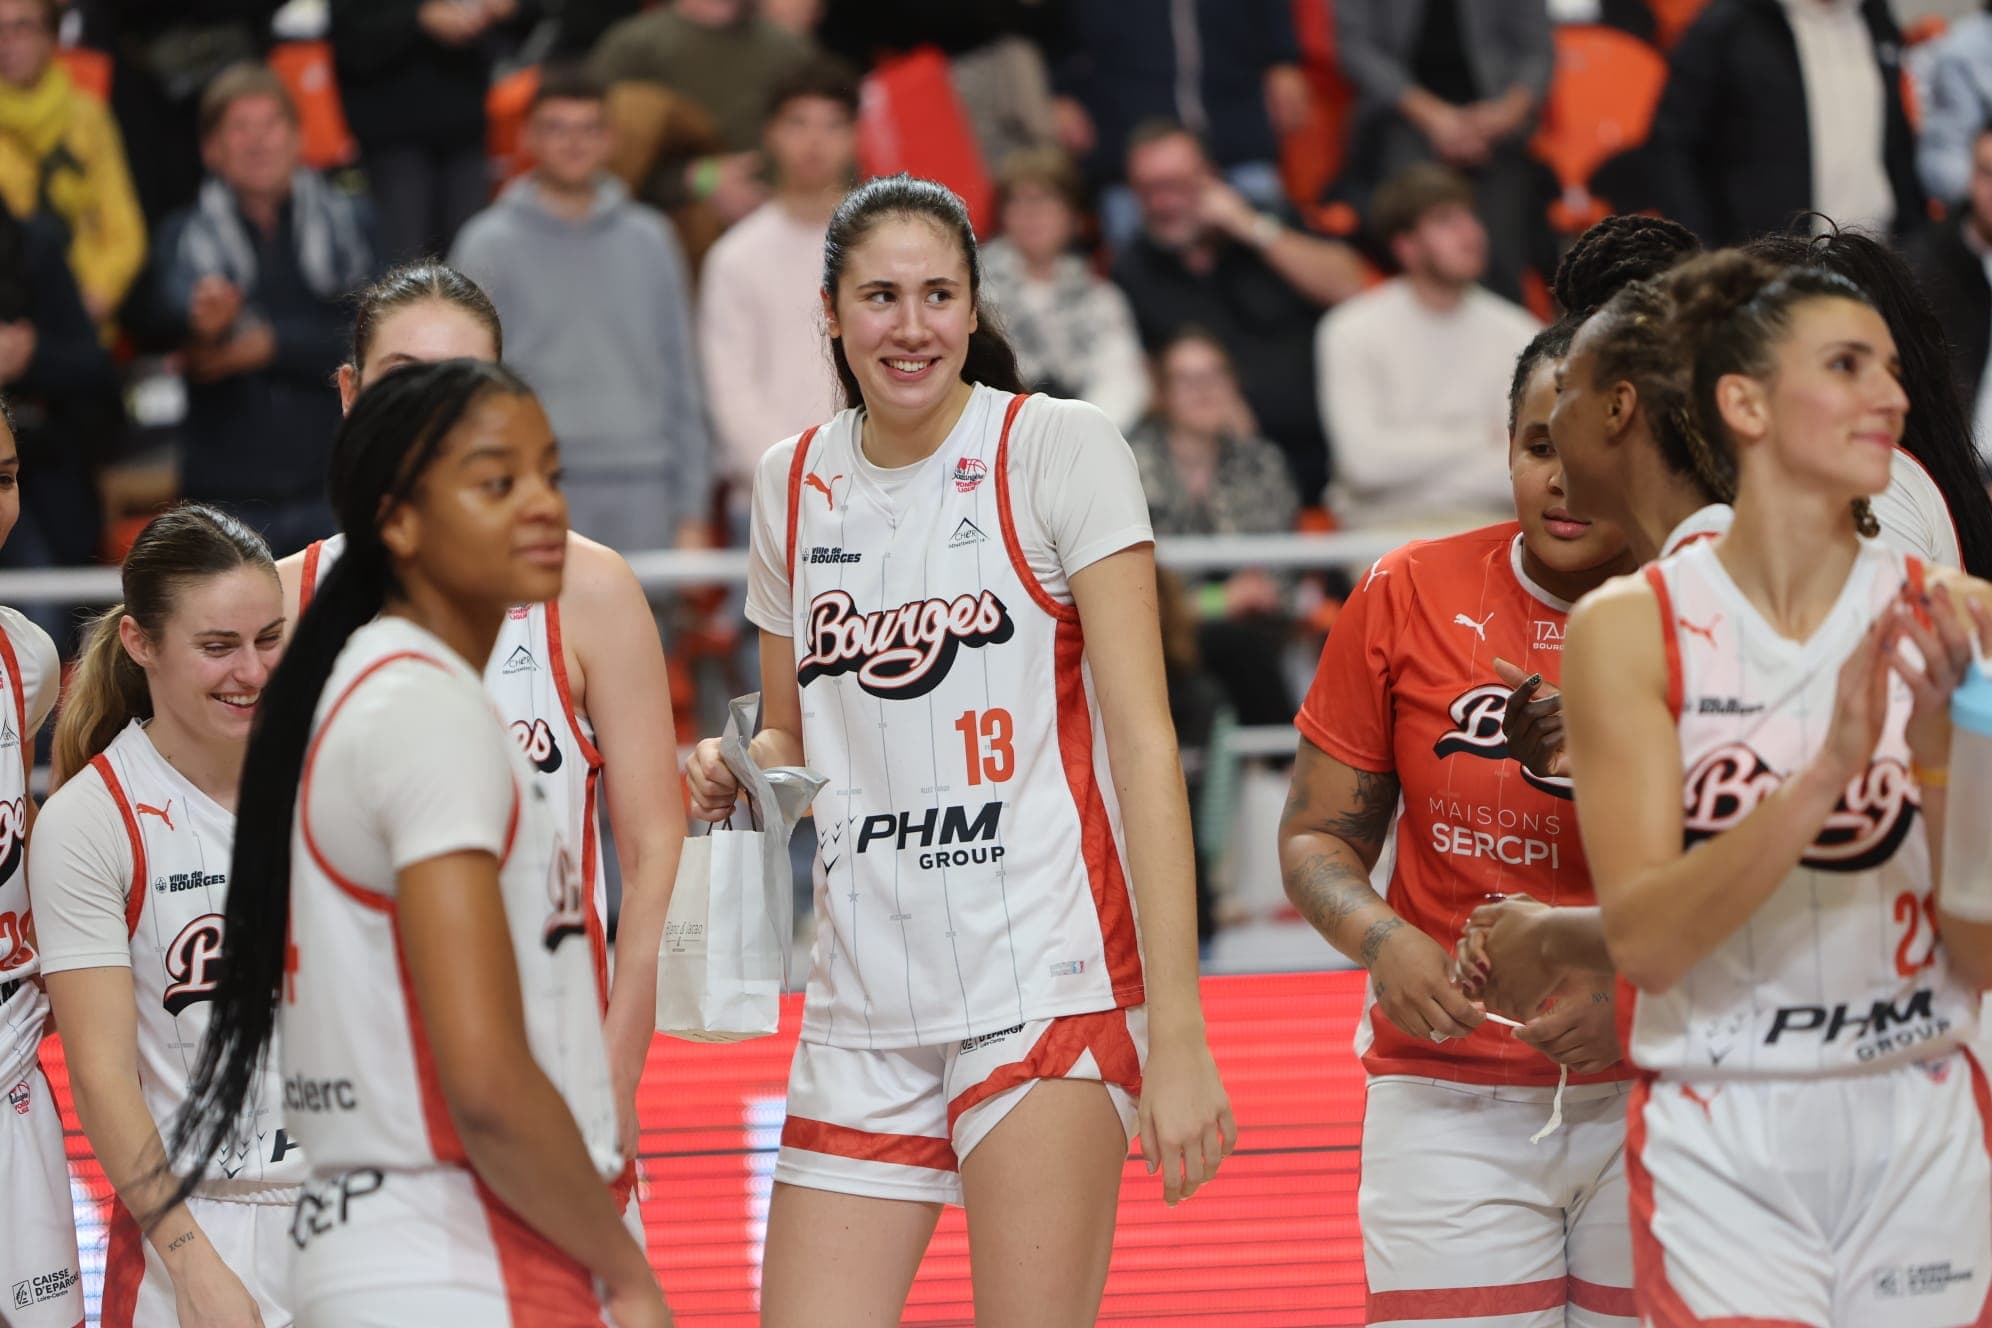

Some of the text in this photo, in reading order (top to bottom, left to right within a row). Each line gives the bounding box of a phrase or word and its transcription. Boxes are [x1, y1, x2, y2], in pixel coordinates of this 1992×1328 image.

[811, 553, 862, 564] BOURGES
[797, 589, 1015, 701] Bourges
[955, 708, 1015, 786] 13
[857, 801, 1003, 854] PHM
[1429, 797, 1561, 835] MAISONS
[919, 846, 1005, 870] GROUP
[1432, 822, 1559, 869] SERCPI
[170, 875, 226, 892] BOURGES
[1763, 988, 1933, 1046] PHM
[282, 1075, 357, 1113] clerc
[33, 1268, 70, 1286] CAISSE
